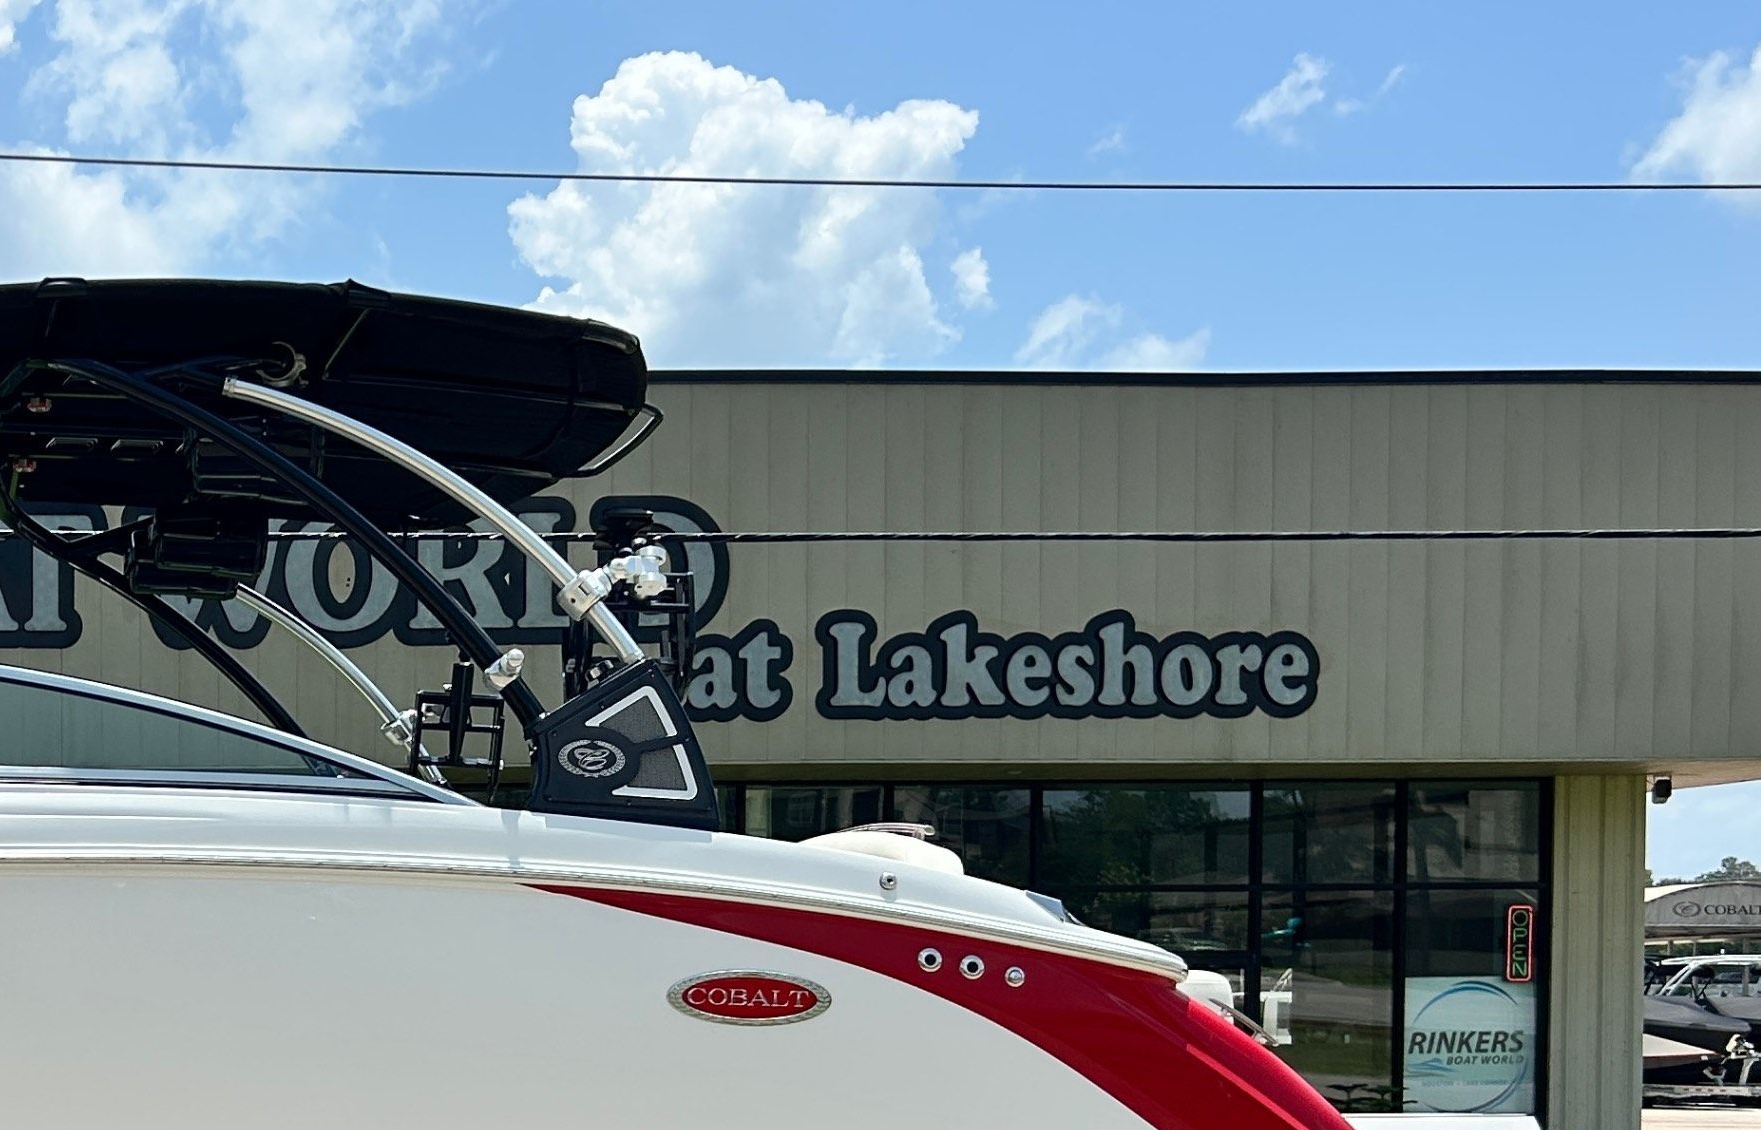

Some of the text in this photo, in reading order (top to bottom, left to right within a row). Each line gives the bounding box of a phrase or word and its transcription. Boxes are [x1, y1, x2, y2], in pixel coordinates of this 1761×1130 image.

[686, 620, 1310, 709] at Lakeshore
[1512, 910, 1529, 977] OPEN
[686, 986, 811, 1008] COBALT
[1408, 1030, 1524, 1055] RINKERS
[1446, 1055, 1524, 1066] BOAT WORLD
